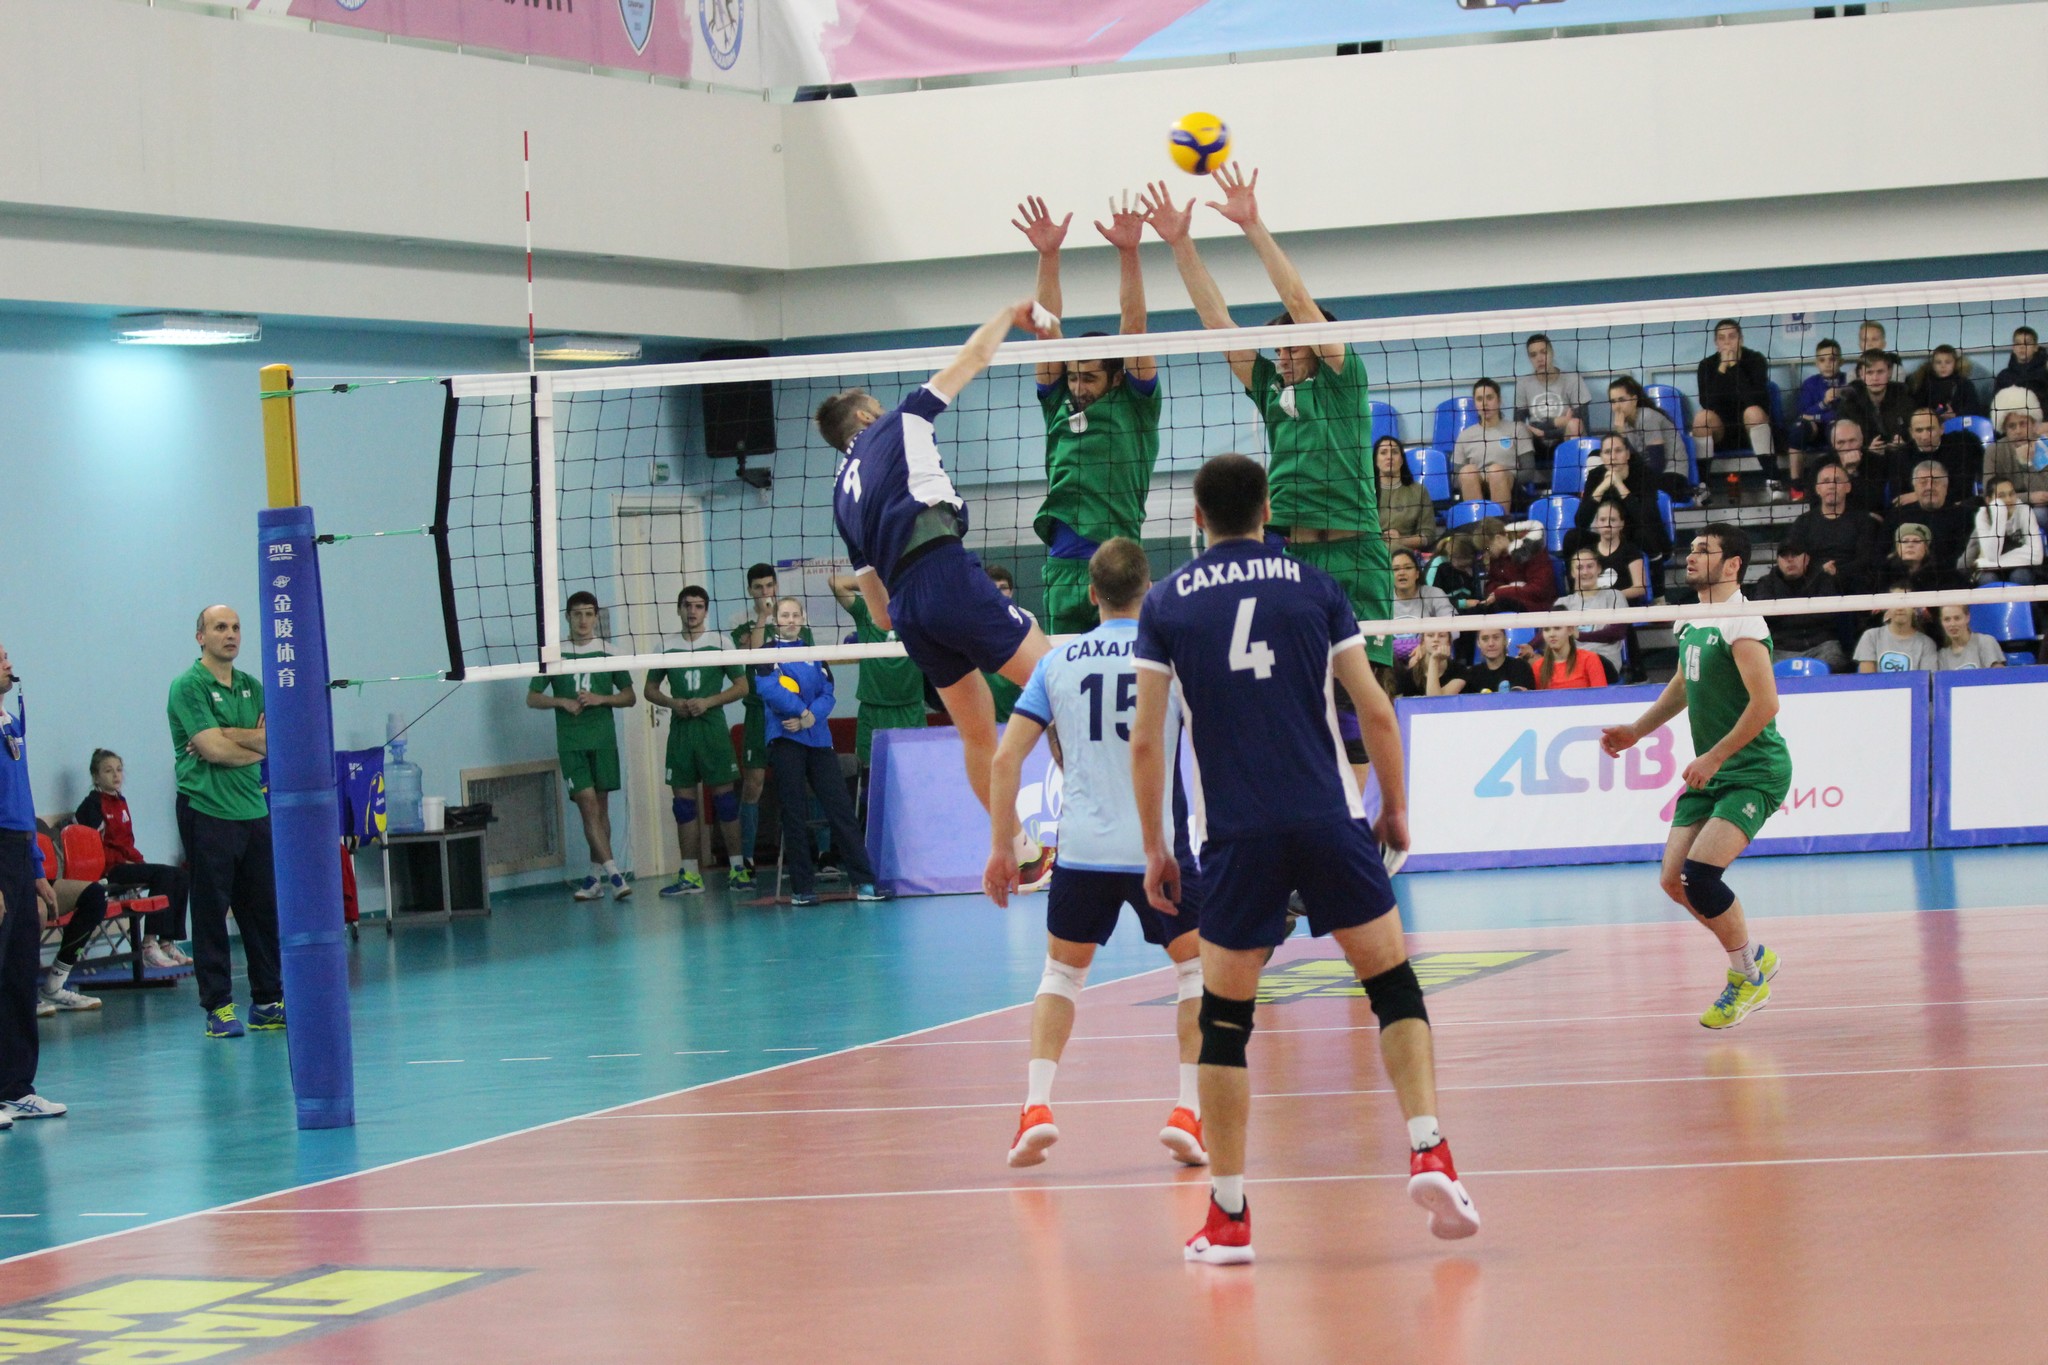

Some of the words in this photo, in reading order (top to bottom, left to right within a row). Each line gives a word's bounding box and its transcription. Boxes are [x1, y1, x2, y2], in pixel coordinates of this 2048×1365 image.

[843, 458, 862, 503] 9
[269, 543, 293, 554] FIVB
[1176, 557, 1301, 597] САХАЛИН
[273, 594, 296, 688] 金陵体育
[1066, 640, 1135, 662] САХАЛ
[1228, 597, 1275, 680] 4
[1080, 673, 1137, 742] 15
